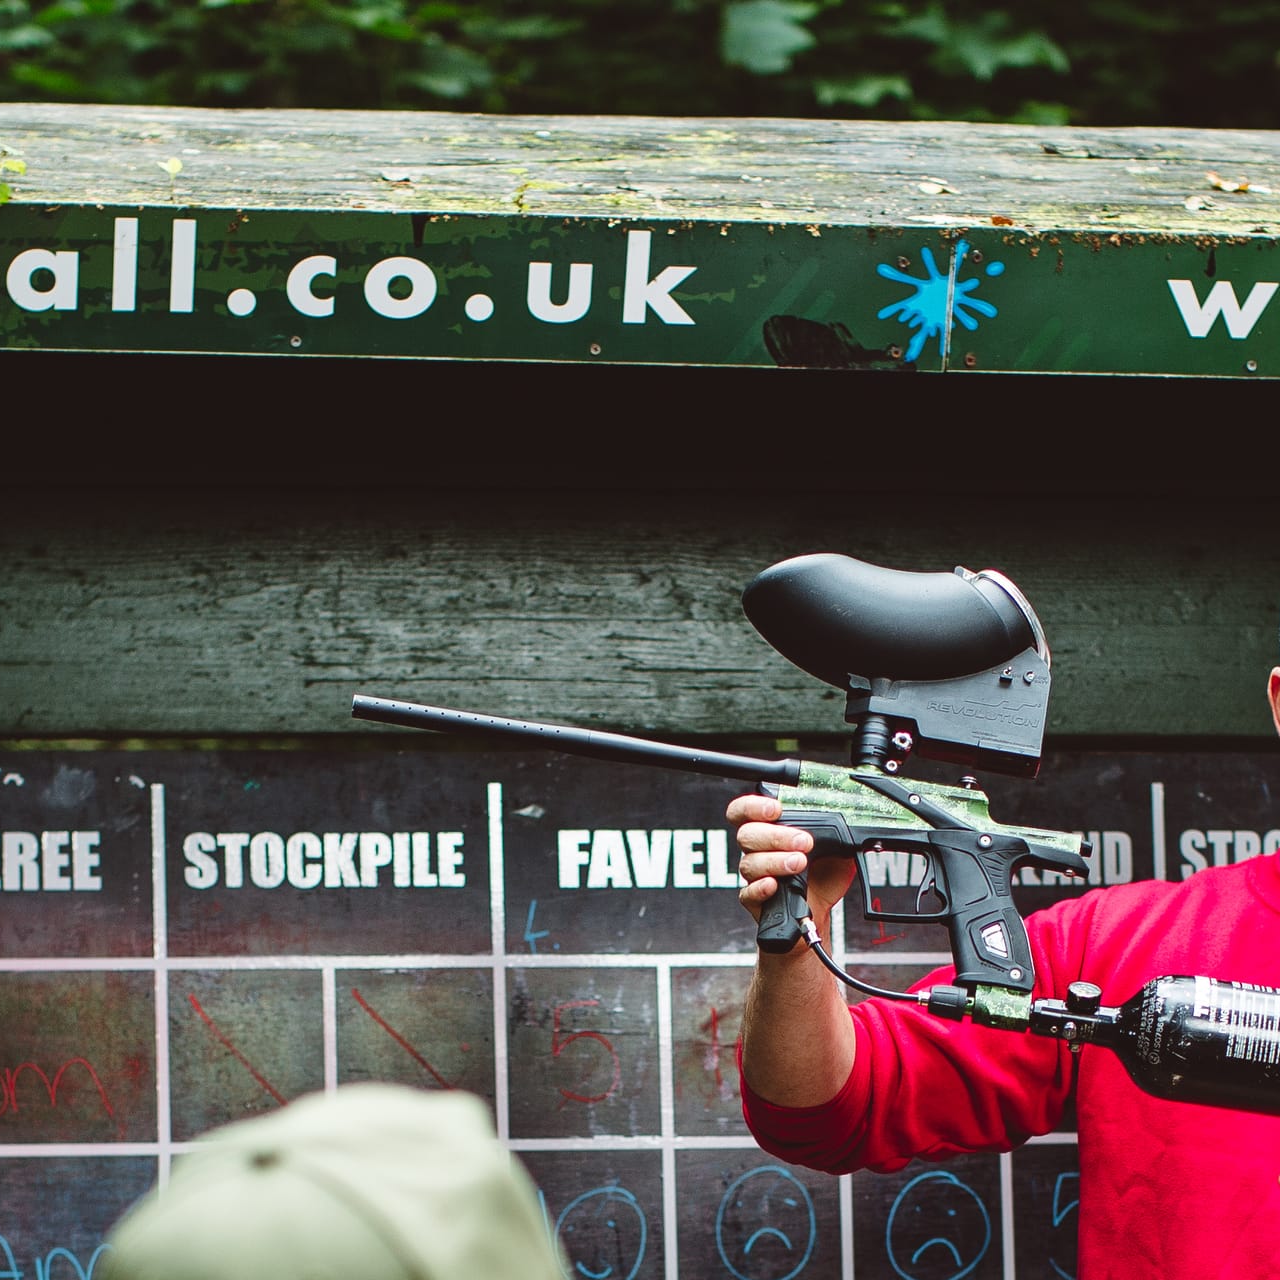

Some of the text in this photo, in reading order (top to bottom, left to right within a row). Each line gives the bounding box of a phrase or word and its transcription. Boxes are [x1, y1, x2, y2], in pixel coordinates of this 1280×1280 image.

[926, 700, 1040, 729] REVOLUTION
[182, 831, 467, 889] STOCKPILE
[557, 829, 748, 889] FAVEL
